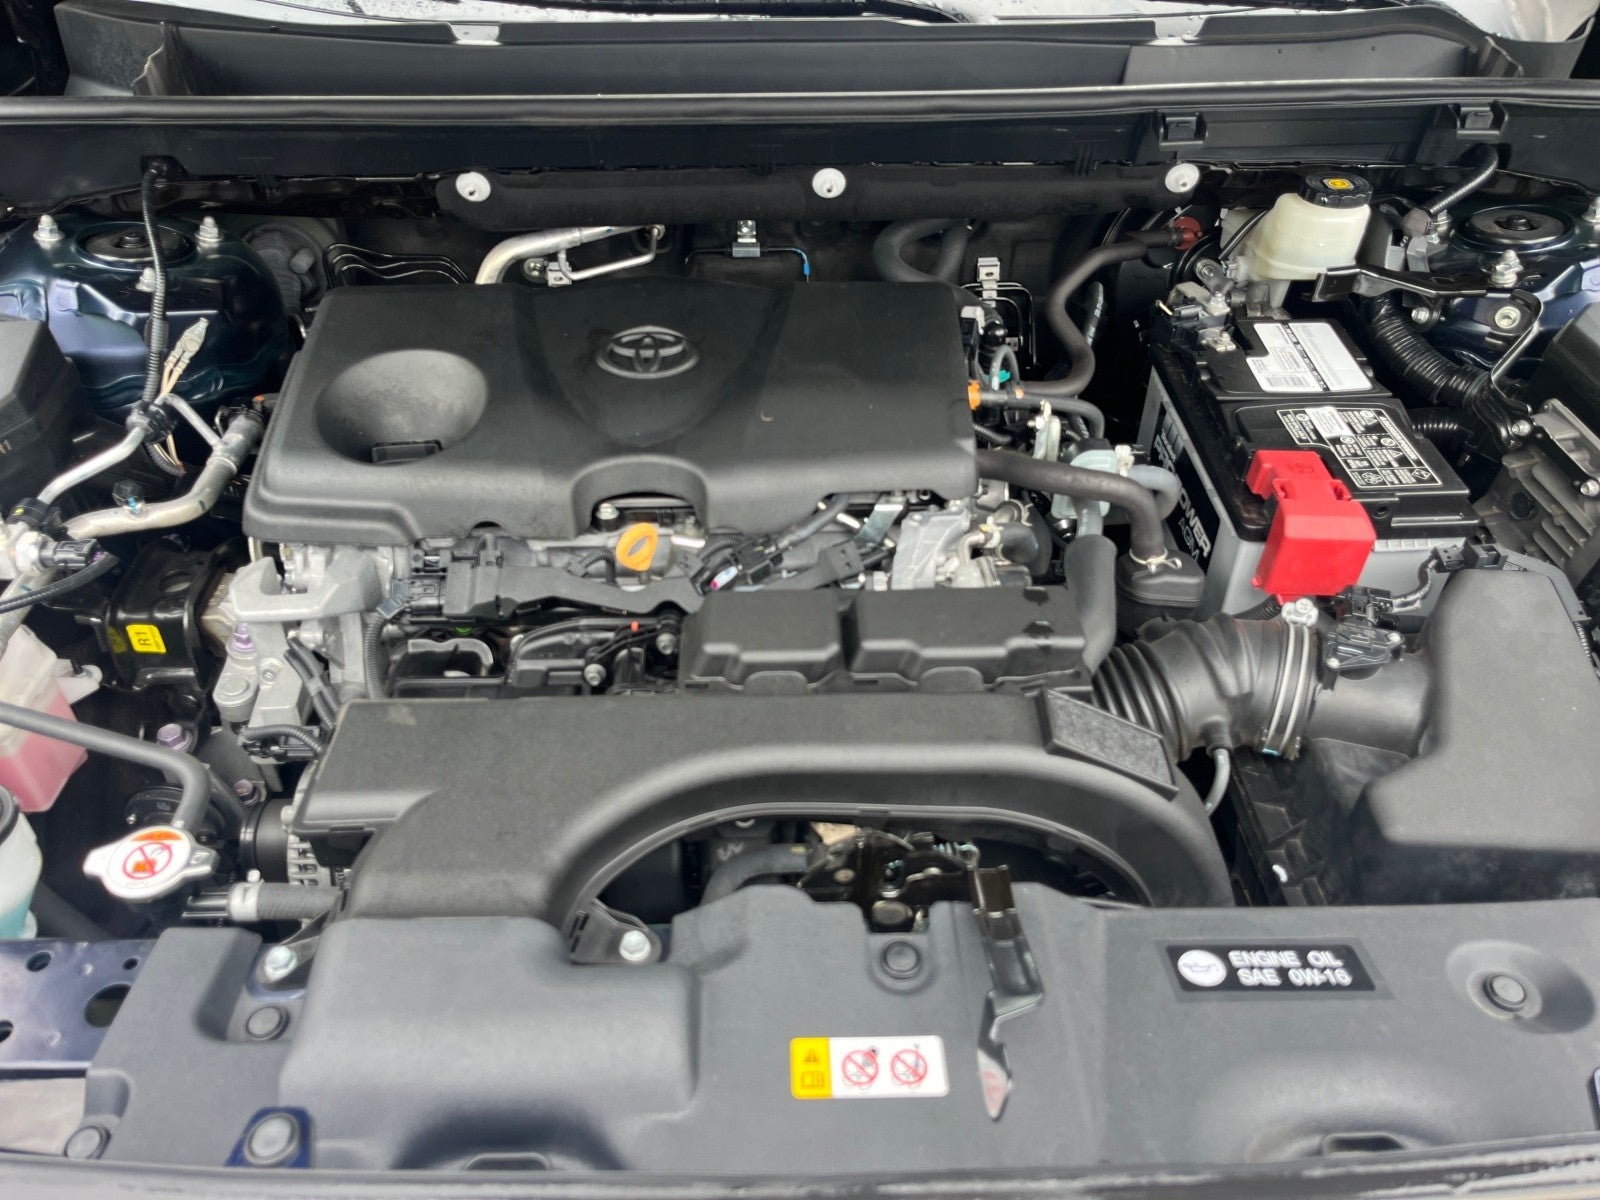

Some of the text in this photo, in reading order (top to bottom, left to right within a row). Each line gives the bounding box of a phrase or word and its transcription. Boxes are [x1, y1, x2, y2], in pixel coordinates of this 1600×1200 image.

[135, 631, 152, 646] R1
[1228, 950, 1344, 968] ENGINE OIL
[1237, 968, 1353, 987] SAE 0W-16
